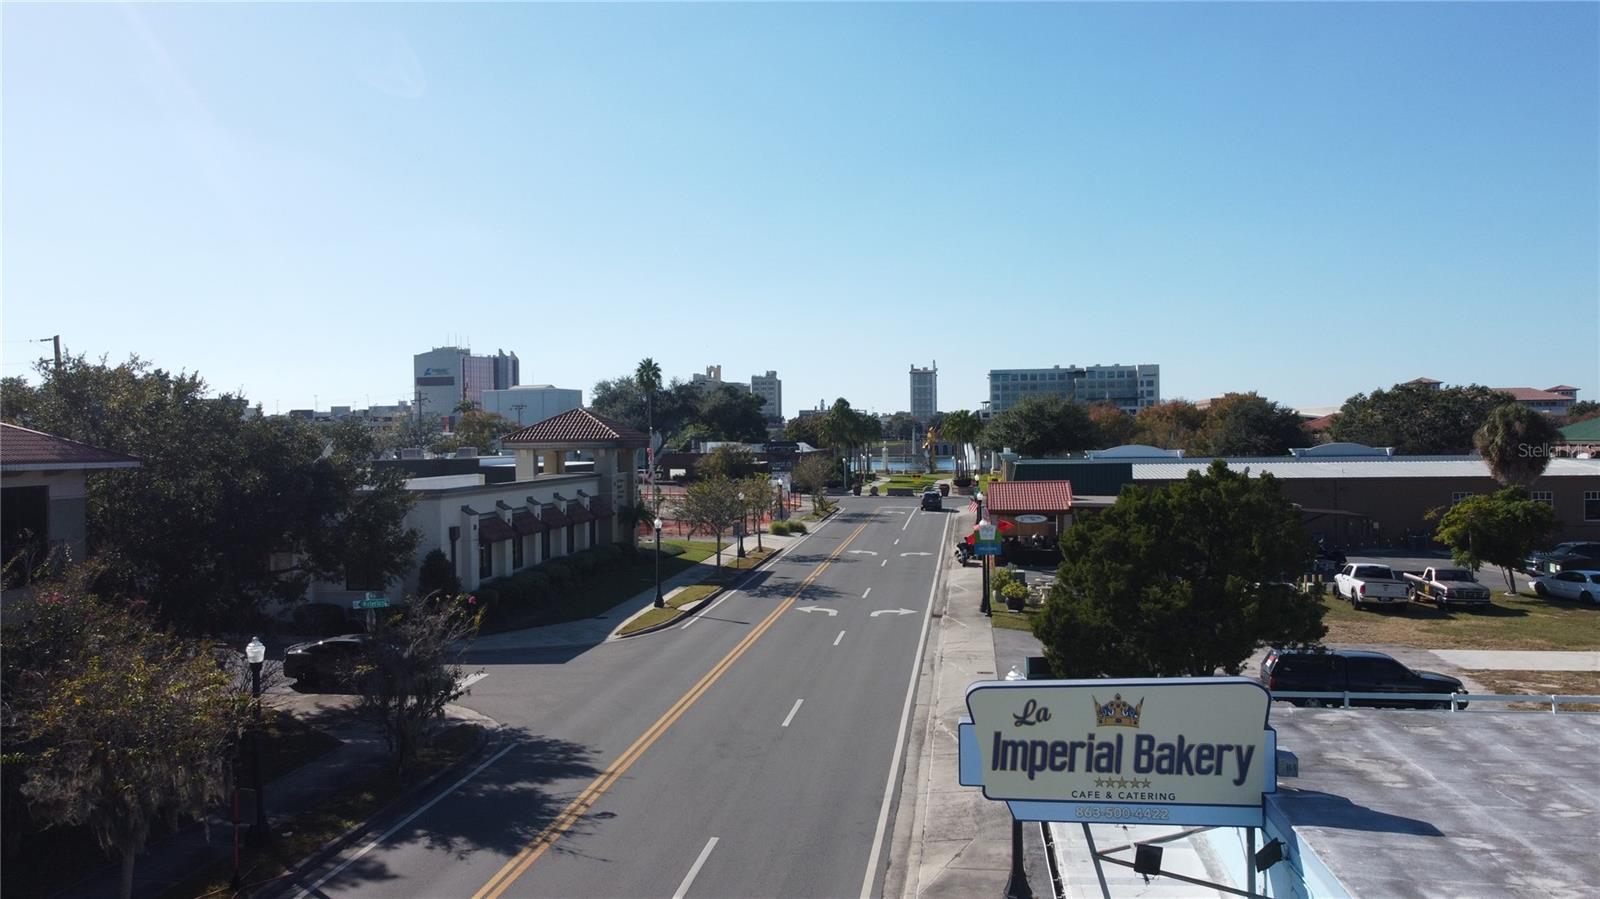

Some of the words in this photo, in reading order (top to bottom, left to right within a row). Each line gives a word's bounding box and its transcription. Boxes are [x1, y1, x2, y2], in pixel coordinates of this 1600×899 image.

[1012, 698, 1052, 728] La
[992, 731, 1124, 781] Imperial
[1133, 733, 1256, 787] Bakery
[1071, 790, 1101, 799] CAFE
[1105, 791, 1113, 800] &
[1118, 791, 1176, 801] CATERING
[1075, 806, 1170, 820] 863-500-4422
